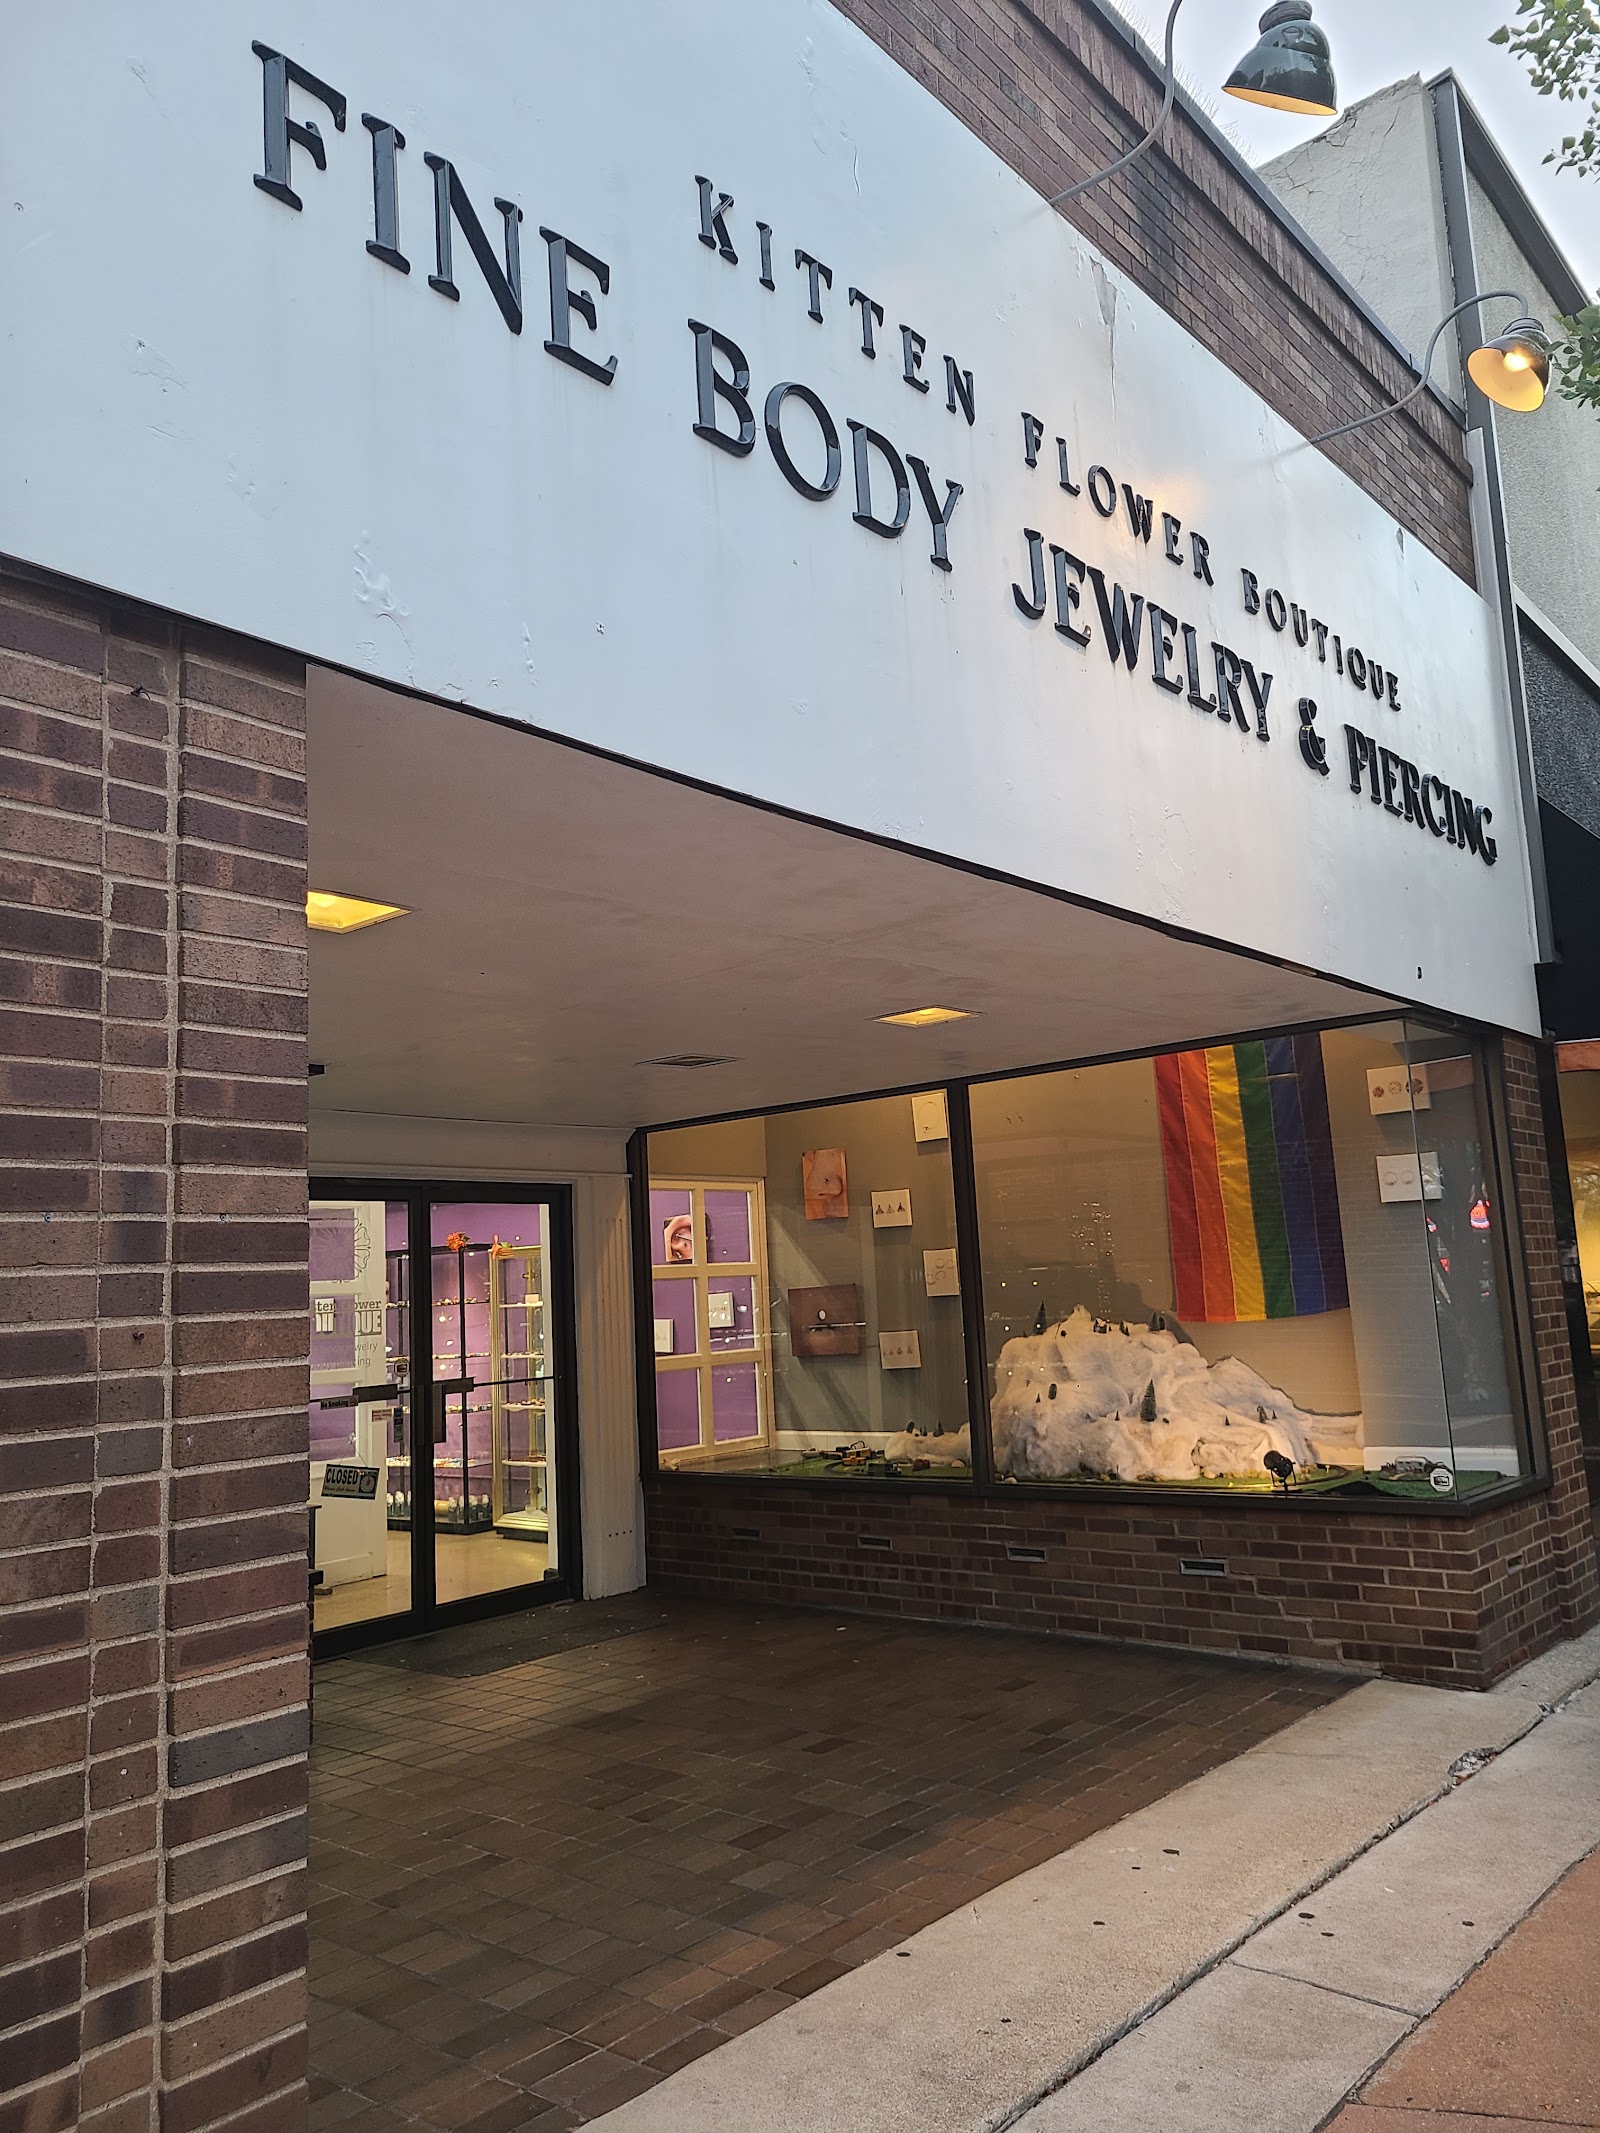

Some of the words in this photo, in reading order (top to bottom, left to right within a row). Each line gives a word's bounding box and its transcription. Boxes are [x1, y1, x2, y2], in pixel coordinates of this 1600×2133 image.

[251, 40, 619, 386] FINE
[688, 318, 964, 572] BODY
[1011, 527, 1274, 743] JEWELRY
[1299, 697, 1331, 776] &
[1344, 723, 1499, 867] PIERCING
[694, 174, 976, 427] KITTEN
[1021, 411, 1214, 587] FLOWER
[1240, 567, 1401, 712] BOUTIQUE
[326, 1468, 359, 1485] CLOSED
[328, 1400, 349, 1408] Smoking
